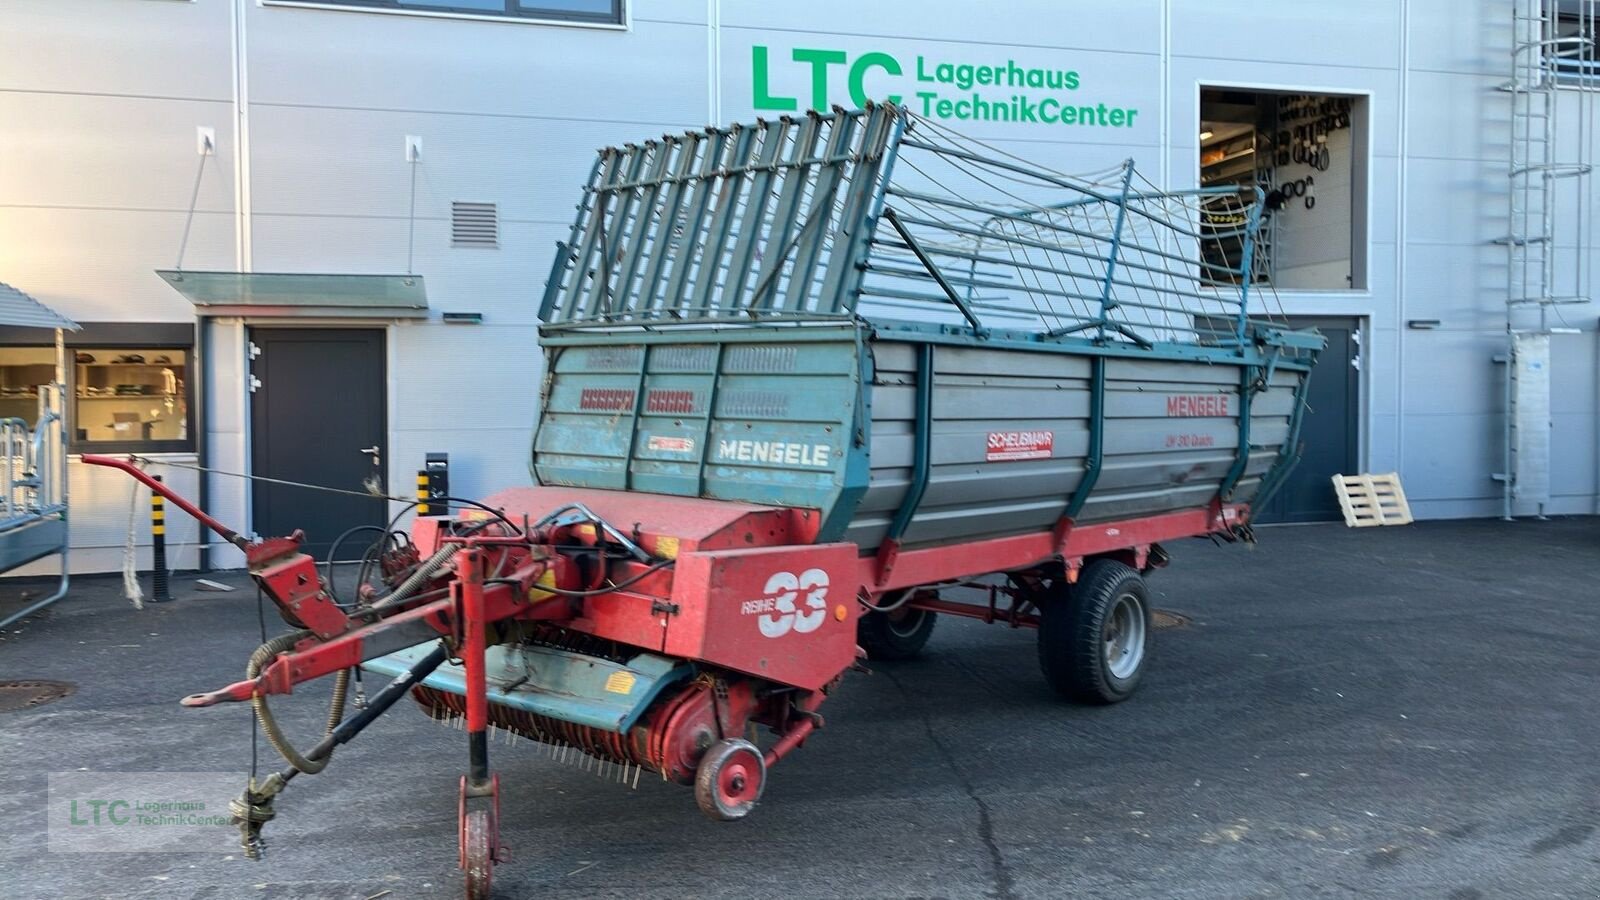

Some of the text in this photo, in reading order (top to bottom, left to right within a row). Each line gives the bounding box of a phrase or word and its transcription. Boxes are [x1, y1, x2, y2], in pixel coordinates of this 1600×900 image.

[752, 46, 903, 112] LTC
[917, 56, 1080, 90] Lagerhaus
[916, 92, 1138, 127] TechnikCenter
[1167, 394, 1228, 417] MENGELE
[718, 440, 831, 467] MENGELE
[741, 598, 775, 615] REIHE
[758, 568, 830, 638] 33
